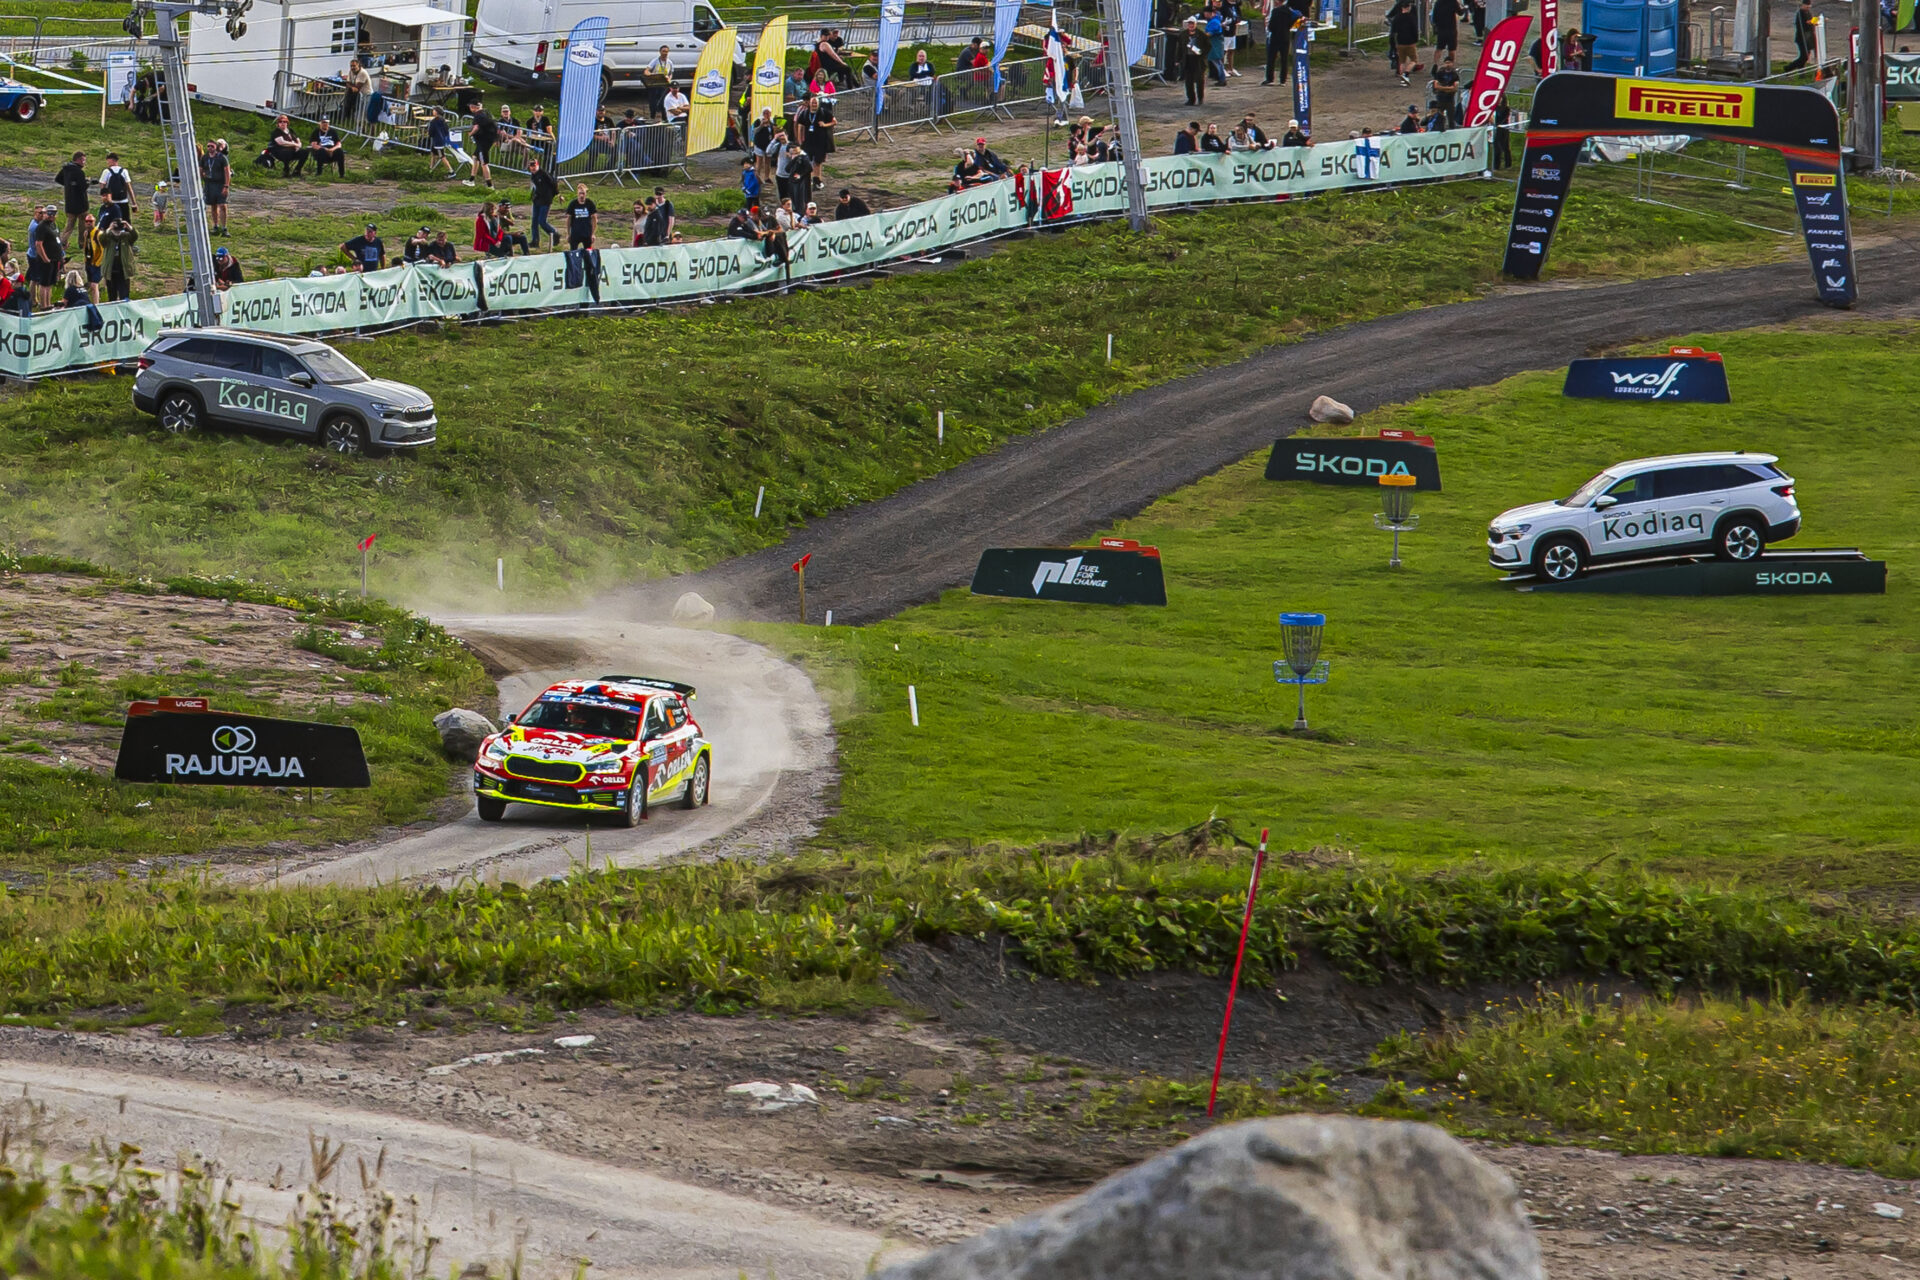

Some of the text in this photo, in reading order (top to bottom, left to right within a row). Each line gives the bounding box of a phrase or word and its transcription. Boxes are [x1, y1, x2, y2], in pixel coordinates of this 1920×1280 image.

[1628, 86, 1743, 119] PIRELLI
[1321, 150, 1391, 176] SKOA
[1614, 386, 1656, 395] LUBRICANTS
[218, 382, 308, 425] Kodiaq
[1295, 452, 1411, 477] SKODA
[1602, 512, 1705, 542] Kodiaq
[1076, 571, 1094, 580] FOR
[1079, 564, 1100, 574] FUEL
[1072, 578, 1109, 588] CHANGE
[1755, 572, 1833, 585] SKODA
[529, 737, 584, 751] ORLEN
[165, 753, 305, 778] RAJUPAJA
[602, 776, 626, 784] ORLEN
